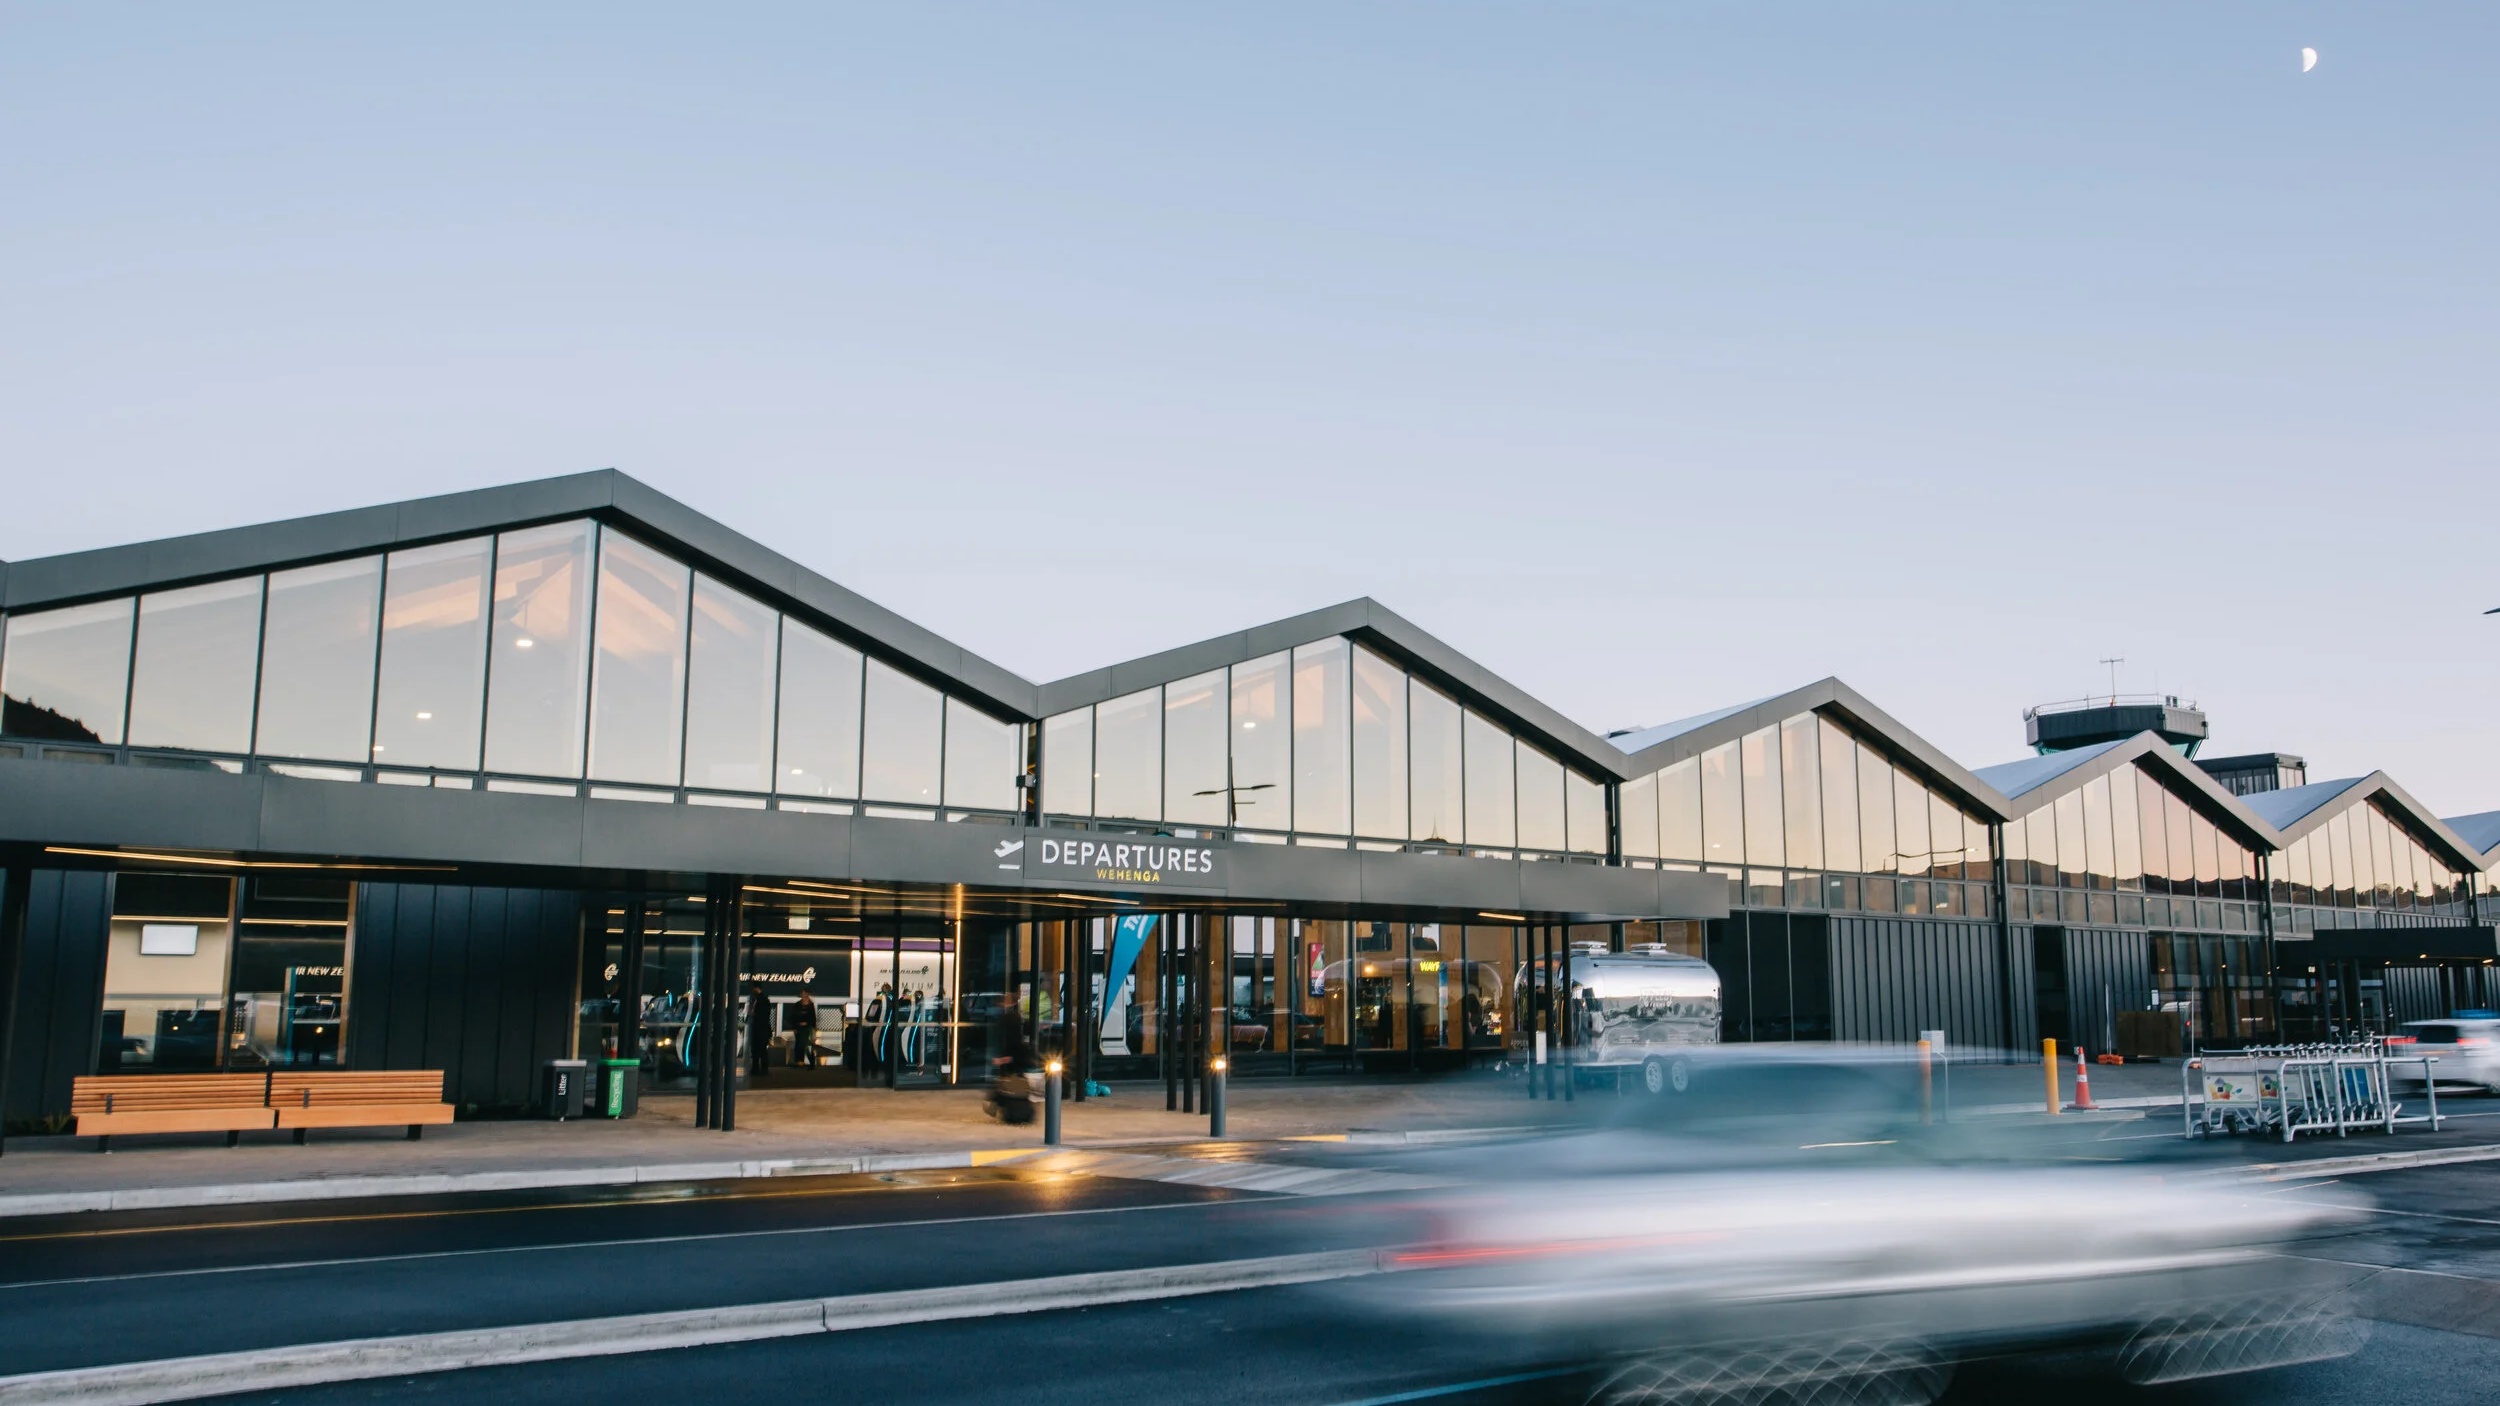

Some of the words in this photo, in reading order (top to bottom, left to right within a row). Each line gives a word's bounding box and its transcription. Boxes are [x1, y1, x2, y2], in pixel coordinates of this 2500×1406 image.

[1042, 839, 1212, 873] DEPARTURES
[1097, 869, 1160, 883] WEHENGA
[295, 966, 306, 976] IR
[307, 966, 330, 976] NEW
[752, 973, 769, 982] NEW
[769, 974, 802, 982] ZEALAND
[558, 1073, 568, 1096] Litter
[611, 1072, 622, 1108] Recycling
